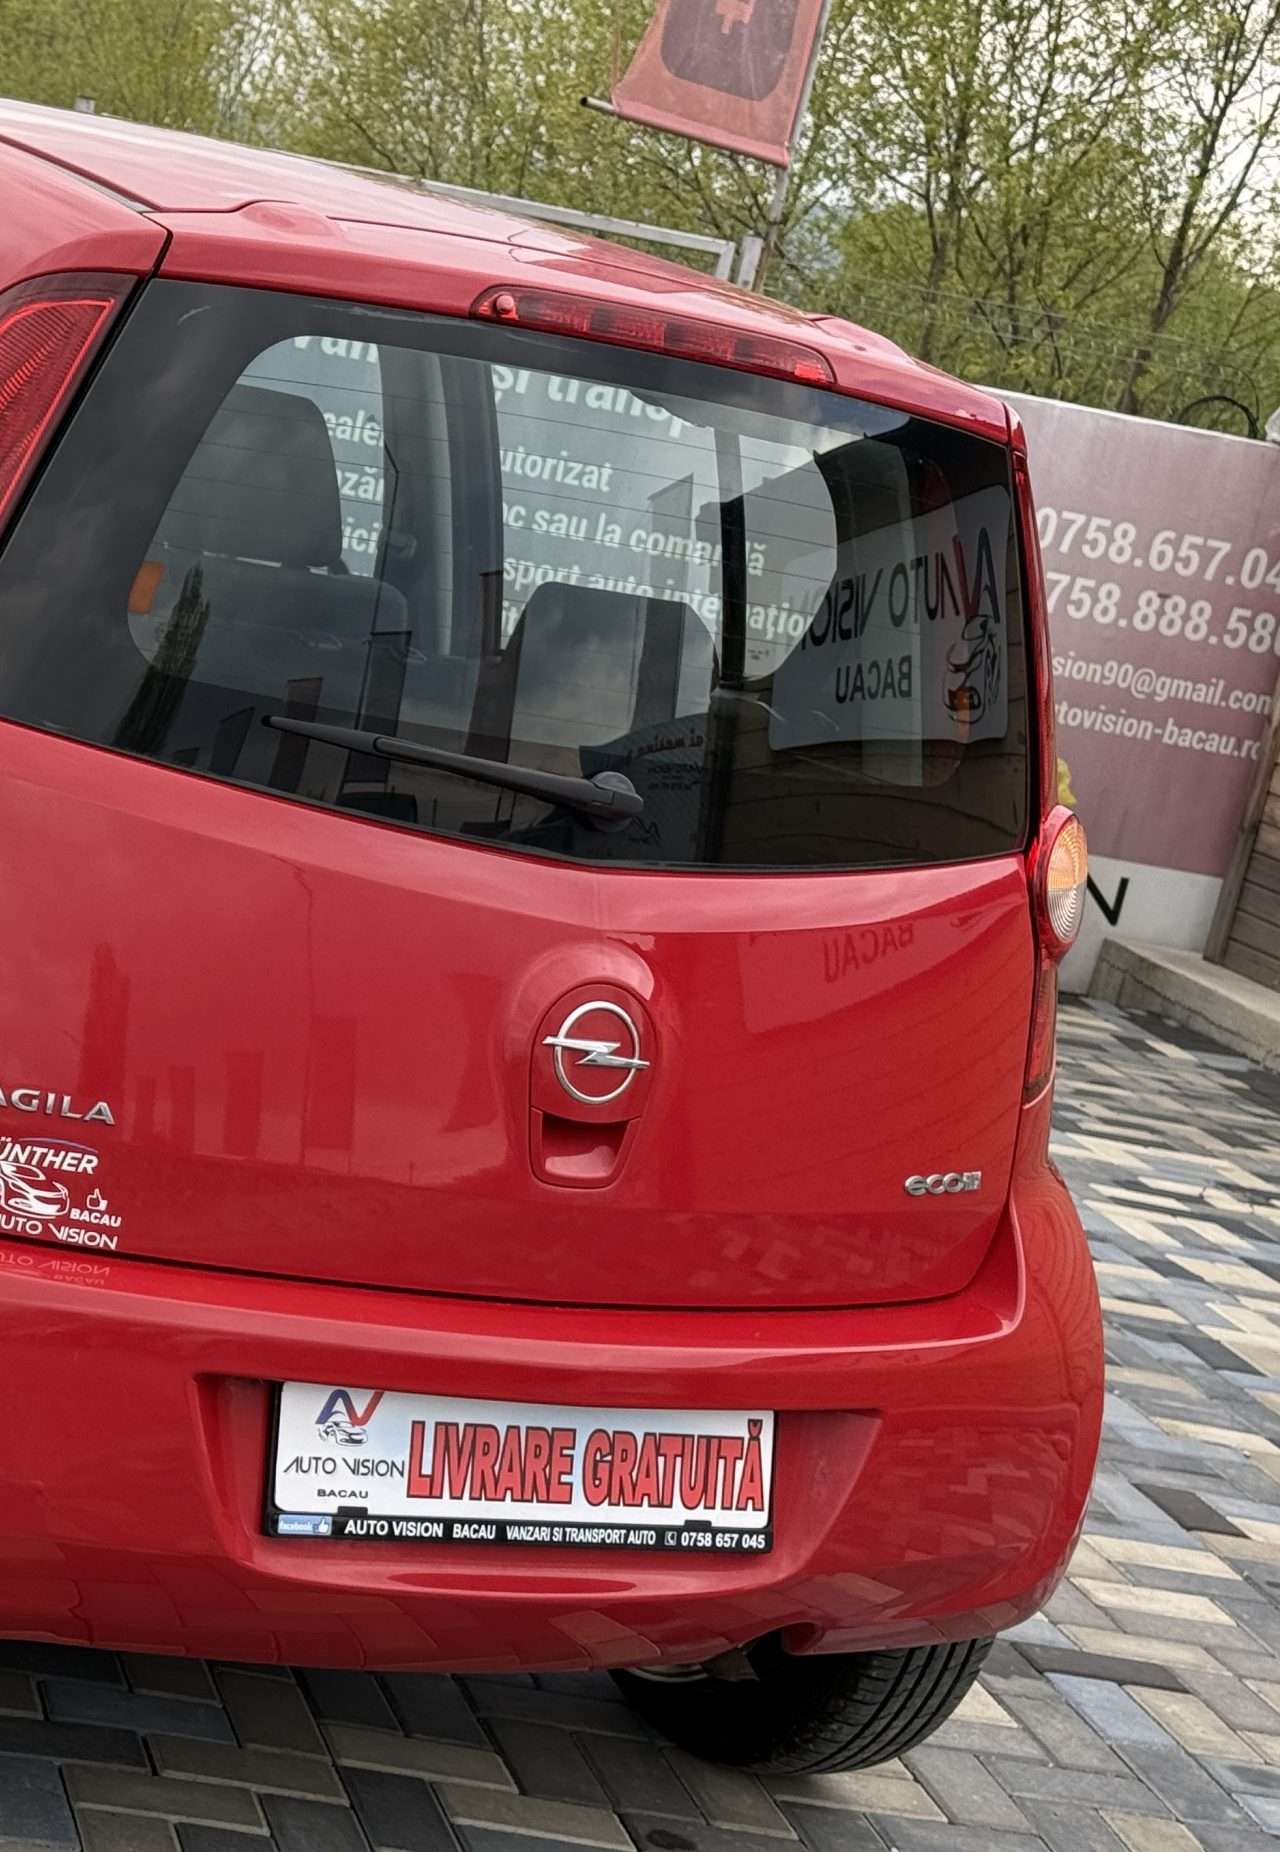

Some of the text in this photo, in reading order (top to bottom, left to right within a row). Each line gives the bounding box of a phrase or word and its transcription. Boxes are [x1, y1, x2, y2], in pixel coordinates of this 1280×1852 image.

[532, 509, 587, 541] sau
[595, 513, 622, 548] la
[70, 1207, 121, 1227] BACAU
[48, 1223, 118, 1249] VISION
[283, 1456, 405, 1478] AUTO VISION
[406, 1419, 765, 1512] LIVRARE GRATUITĂ
[317, 1488, 369, 1499] BACAU
[344, 1520, 766, 1549] AUTO VISION BACAU VANZARI SI TRANSPORT AUTO 0758 657 045
